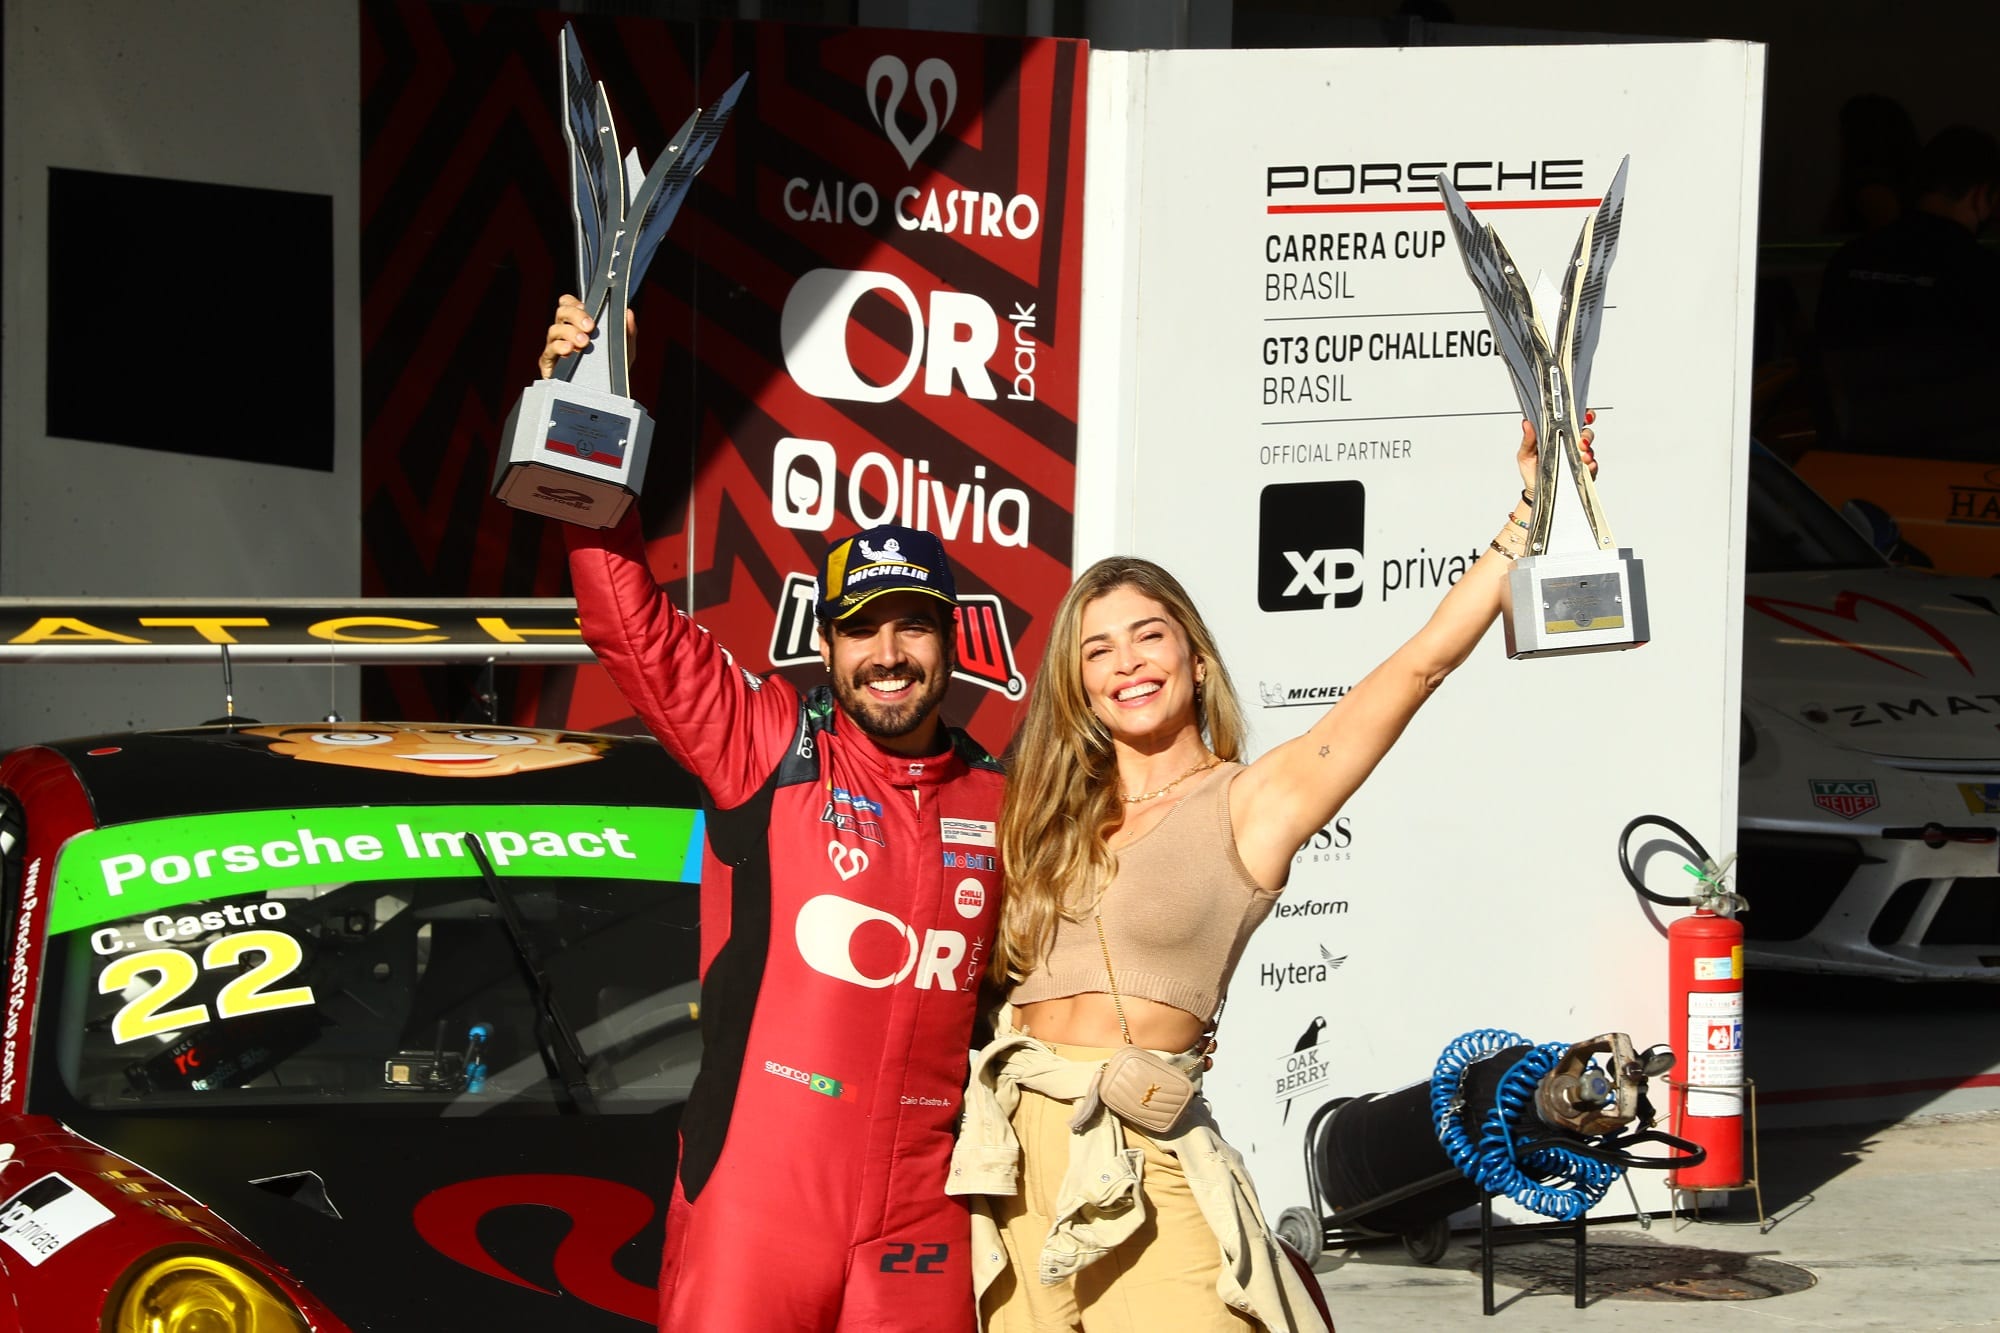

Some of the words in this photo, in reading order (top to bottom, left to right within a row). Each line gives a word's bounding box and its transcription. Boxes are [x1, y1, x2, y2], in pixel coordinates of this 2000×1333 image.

[1267, 159, 1584, 197] PORSCHE
[783, 177, 880, 227] CAIO
[895, 186, 1040, 240] CASTRO
[1265, 232, 1387, 264] CARRERA
[1394, 230, 1446, 259] CUP
[1264, 271, 1355, 302] BRASIL
[1007, 301, 1037, 402] bank
[1262, 336, 1309, 367] GT3
[1314, 333, 1364, 363] CUP
[1262, 374, 1353, 406] BRASIL
[1259, 444, 1334, 466] OFFICIAL
[1337, 440, 1412, 462] PARTNER
[847, 451, 1031, 549] Olivia
[846, 566, 929, 586] MICHELIN
[1281, 548, 1366, 609] XP
[1382, 547, 1481, 602] privat
[1287, 686, 1352, 700] MICHEL
[1817, 783, 1871, 795] TAG
[1818, 796, 1876, 817] HEUER
[99, 827, 384, 897] Porsche
[395, 823, 638, 867] Impact
[943, 851, 985, 870] Mobil
[958, 897, 982, 907] BEANS
[960, 889, 982, 898] CHILLI
[1275, 899, 1348, 919] lexform
[91, 928, 136, 955] C.
[143, 902, 287, 942] Castro
[961, 936, 985, 992] bank
[1261, 962, 1327, 993] Hytera
[98, 930, 316, 1045] 22
[764, 1060, 811, 1085] sparco
[1286, 1048, 1319, 1073] OAK
[1275, 1061, 1330, 1095] BERRY
[900, 1094, 918, 1106] Caio
[919, 1096, 942, 1108] Castro
[10, 1219, 60, 1255] private
[880, 1242, 949, 1273] 22
